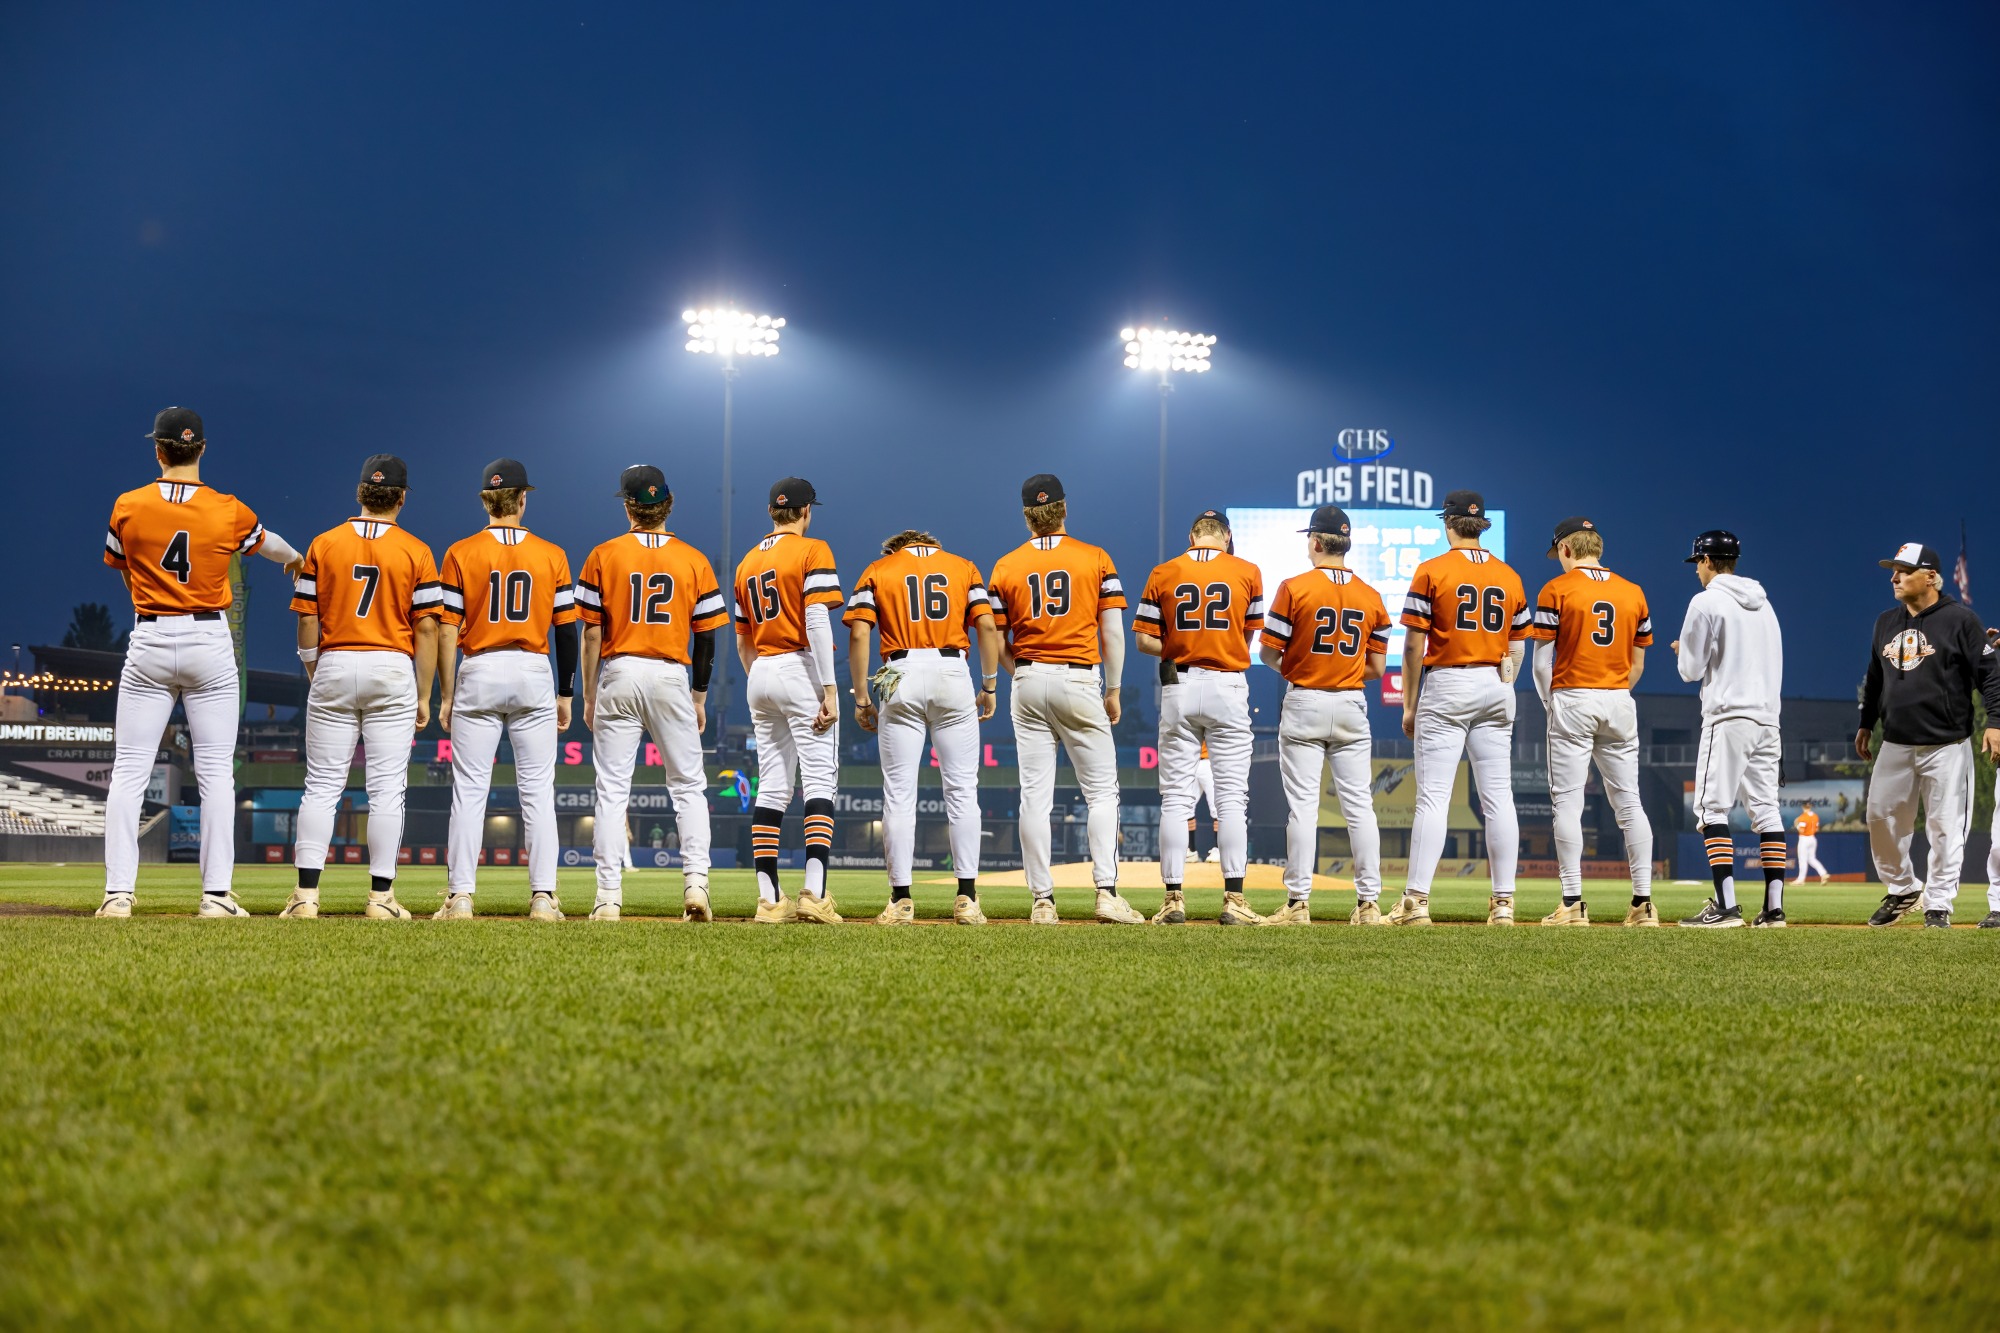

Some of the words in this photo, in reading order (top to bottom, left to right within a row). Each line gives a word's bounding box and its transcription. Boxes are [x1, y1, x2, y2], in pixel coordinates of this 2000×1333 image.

[1338, 429, 1390, 450] CHS
[1297, 466, 1351, 507] CHS
[1361, 465, 1433, 509] FIELD
[160, 531, 191, 584] 4
[352, 564, 380, 618] 7
[489, 570, 532, 623] 10
[629, 572, 675, 625] 12
[746, 569, 781, 625] 15
[905, 573, 949, 623] 16
[1027, 570, 1071, 619] 19
[1174, 582, 1231, 631] 22
[1455, 584, 1505, 633] 26
[1311, 607, 1365, 657] 25
[1591, 600, 1615, 647] 3
[45, 725, 114, 742] BREWING
[48, 749, 83, 759] CRAFT
[86, 768, 113, 781] OAT
